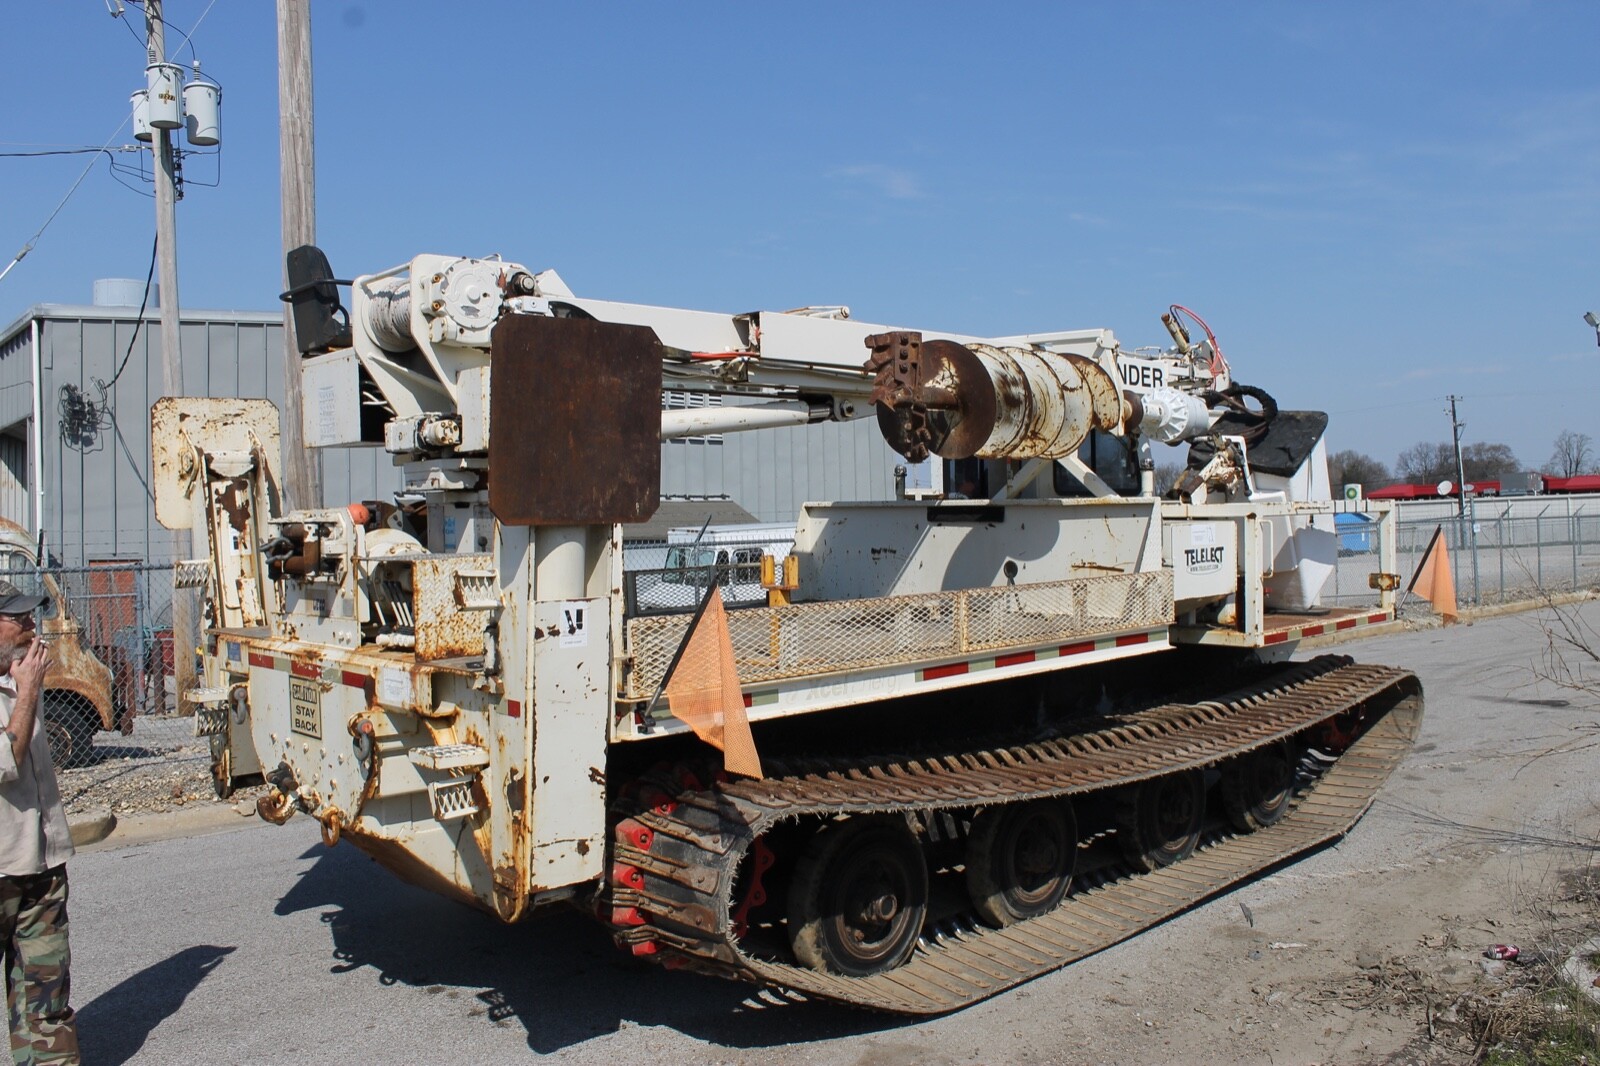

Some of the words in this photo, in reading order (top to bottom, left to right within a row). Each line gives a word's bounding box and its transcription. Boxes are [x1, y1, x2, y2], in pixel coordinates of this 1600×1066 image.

[1184, 546, 1224, 567] TELELECT
[295, 704, 316, 719] STAY
[295, 718, 317, 734] BACK
